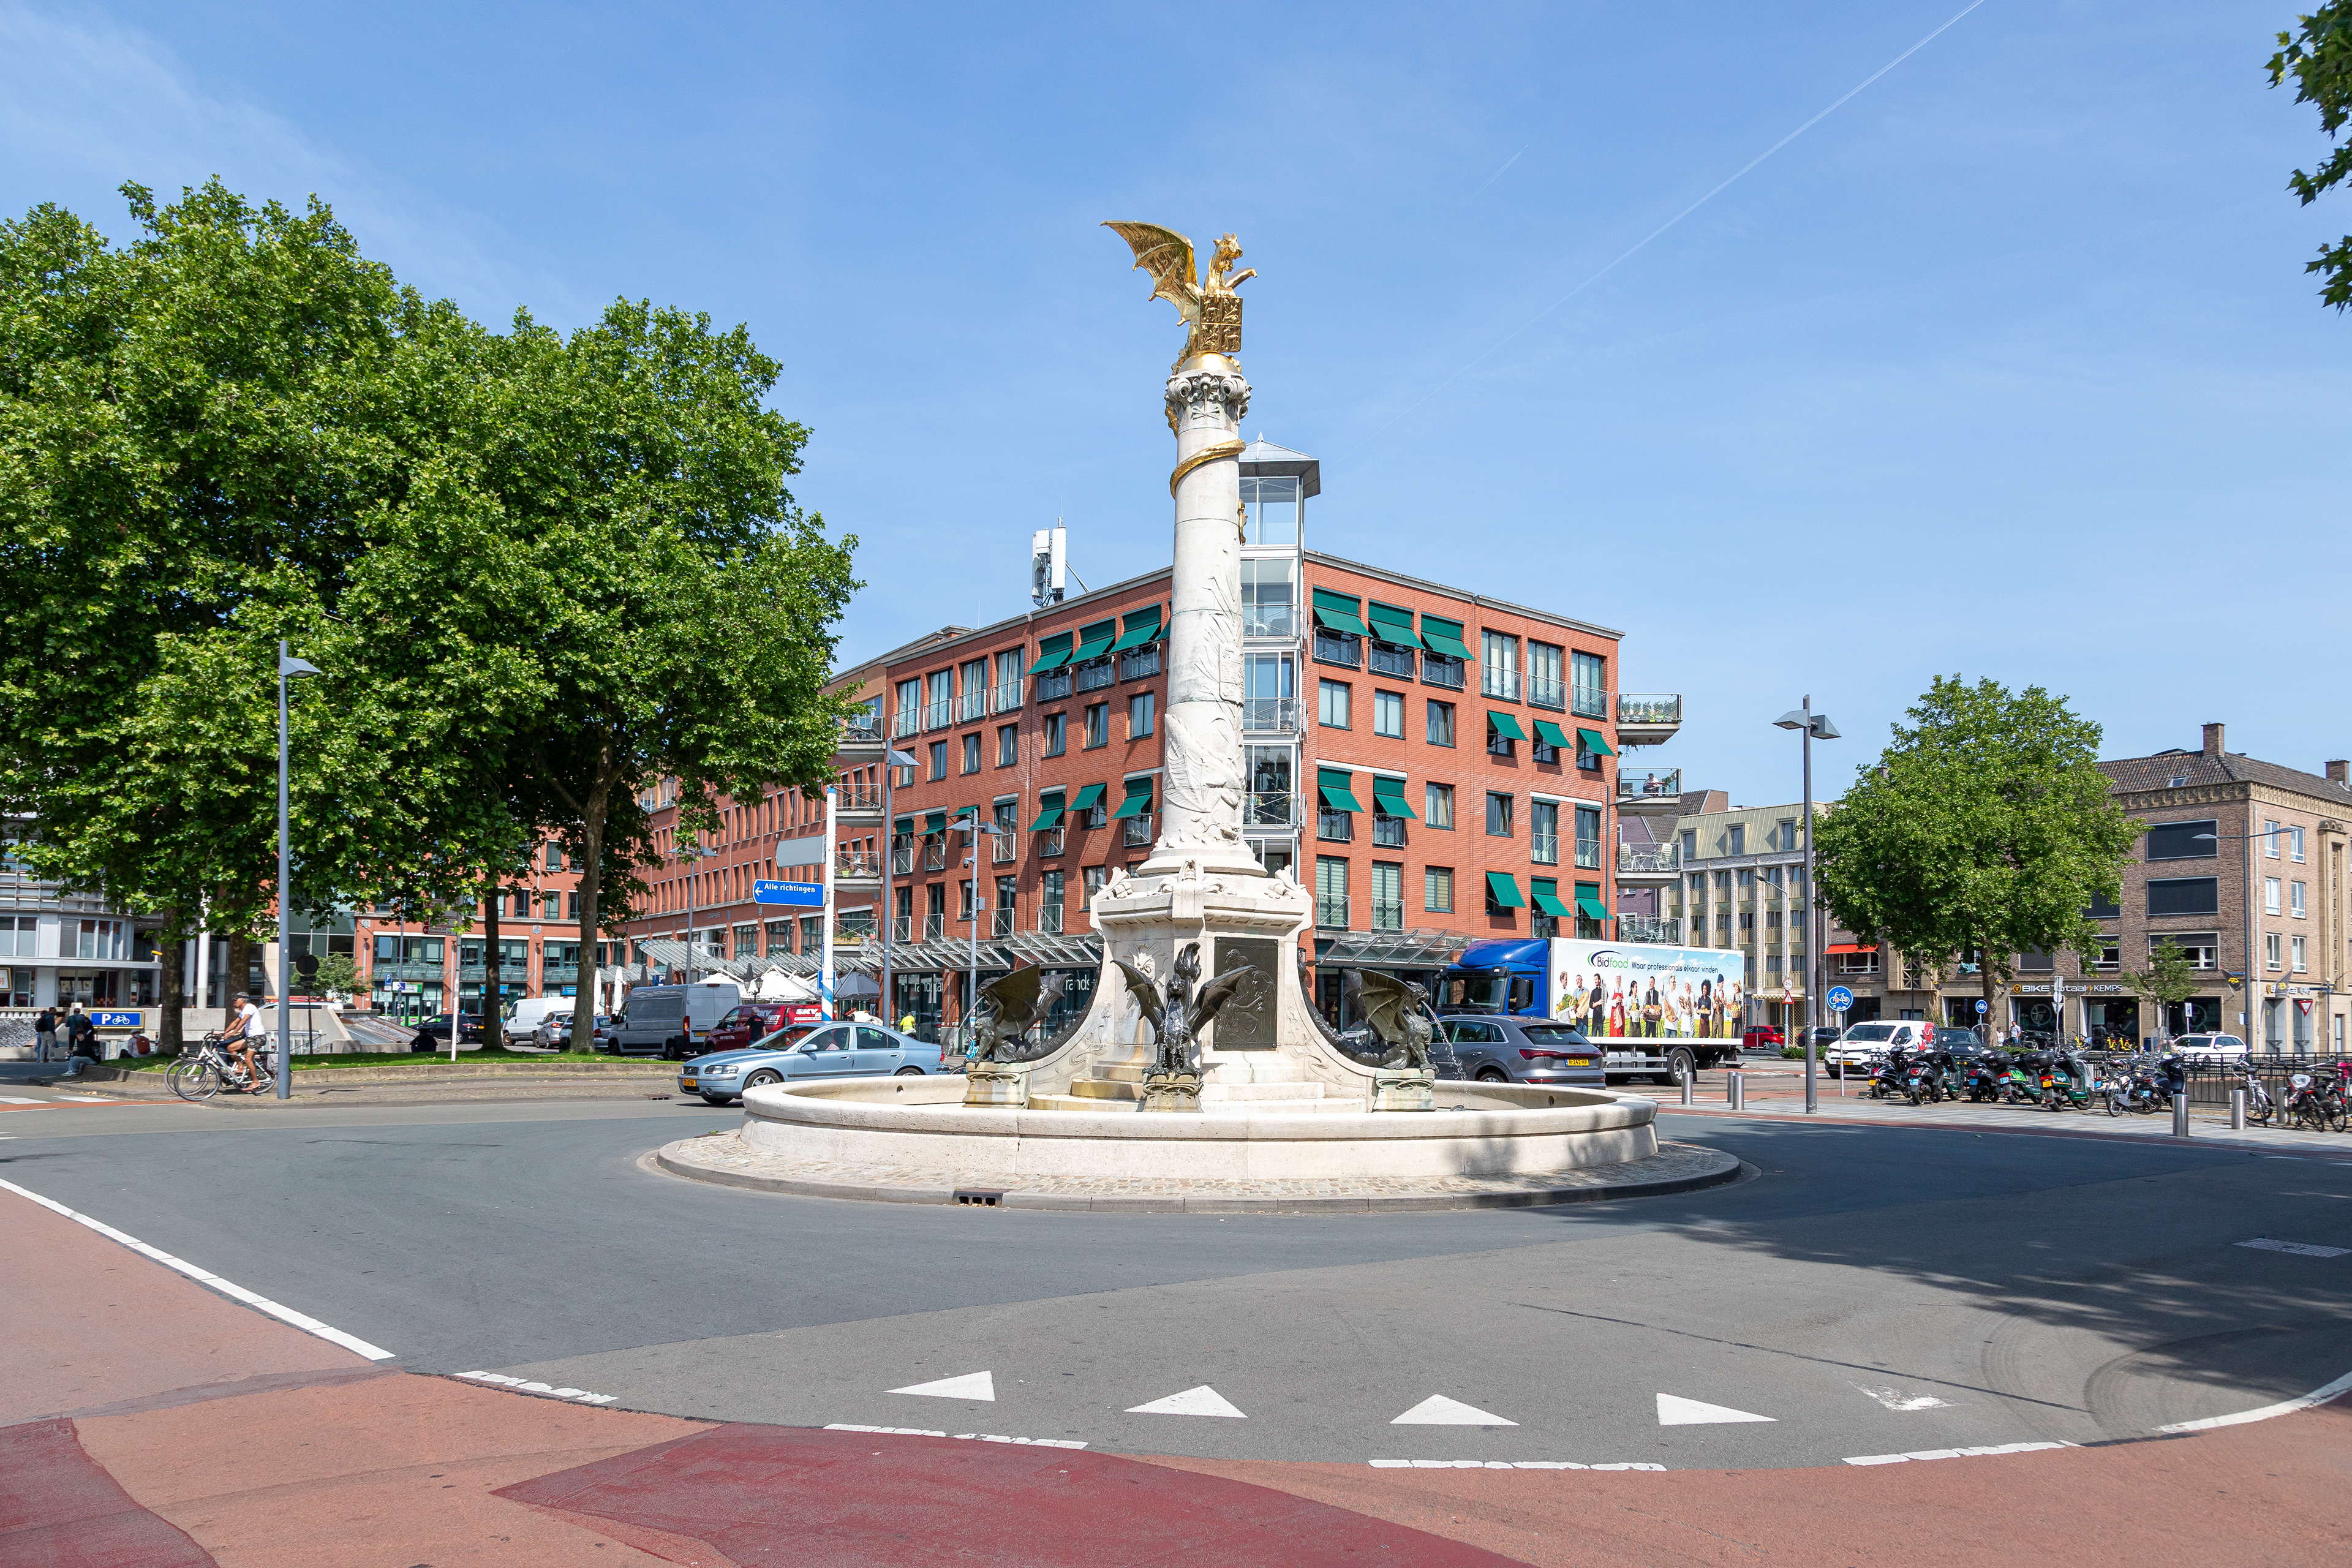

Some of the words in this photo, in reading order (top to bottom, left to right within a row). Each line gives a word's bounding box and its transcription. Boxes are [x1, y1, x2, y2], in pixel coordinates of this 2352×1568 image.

[780, 884, 815, 894] richtingen
[1597, 956, 1629, 969] Bidfood
[1631, 961, 1646, 970] Waar
[1647, 962, 1683, 972] professionals
[1683, 964, 1700, 973] elkaar
[102, 1014, 111, 1024] P
